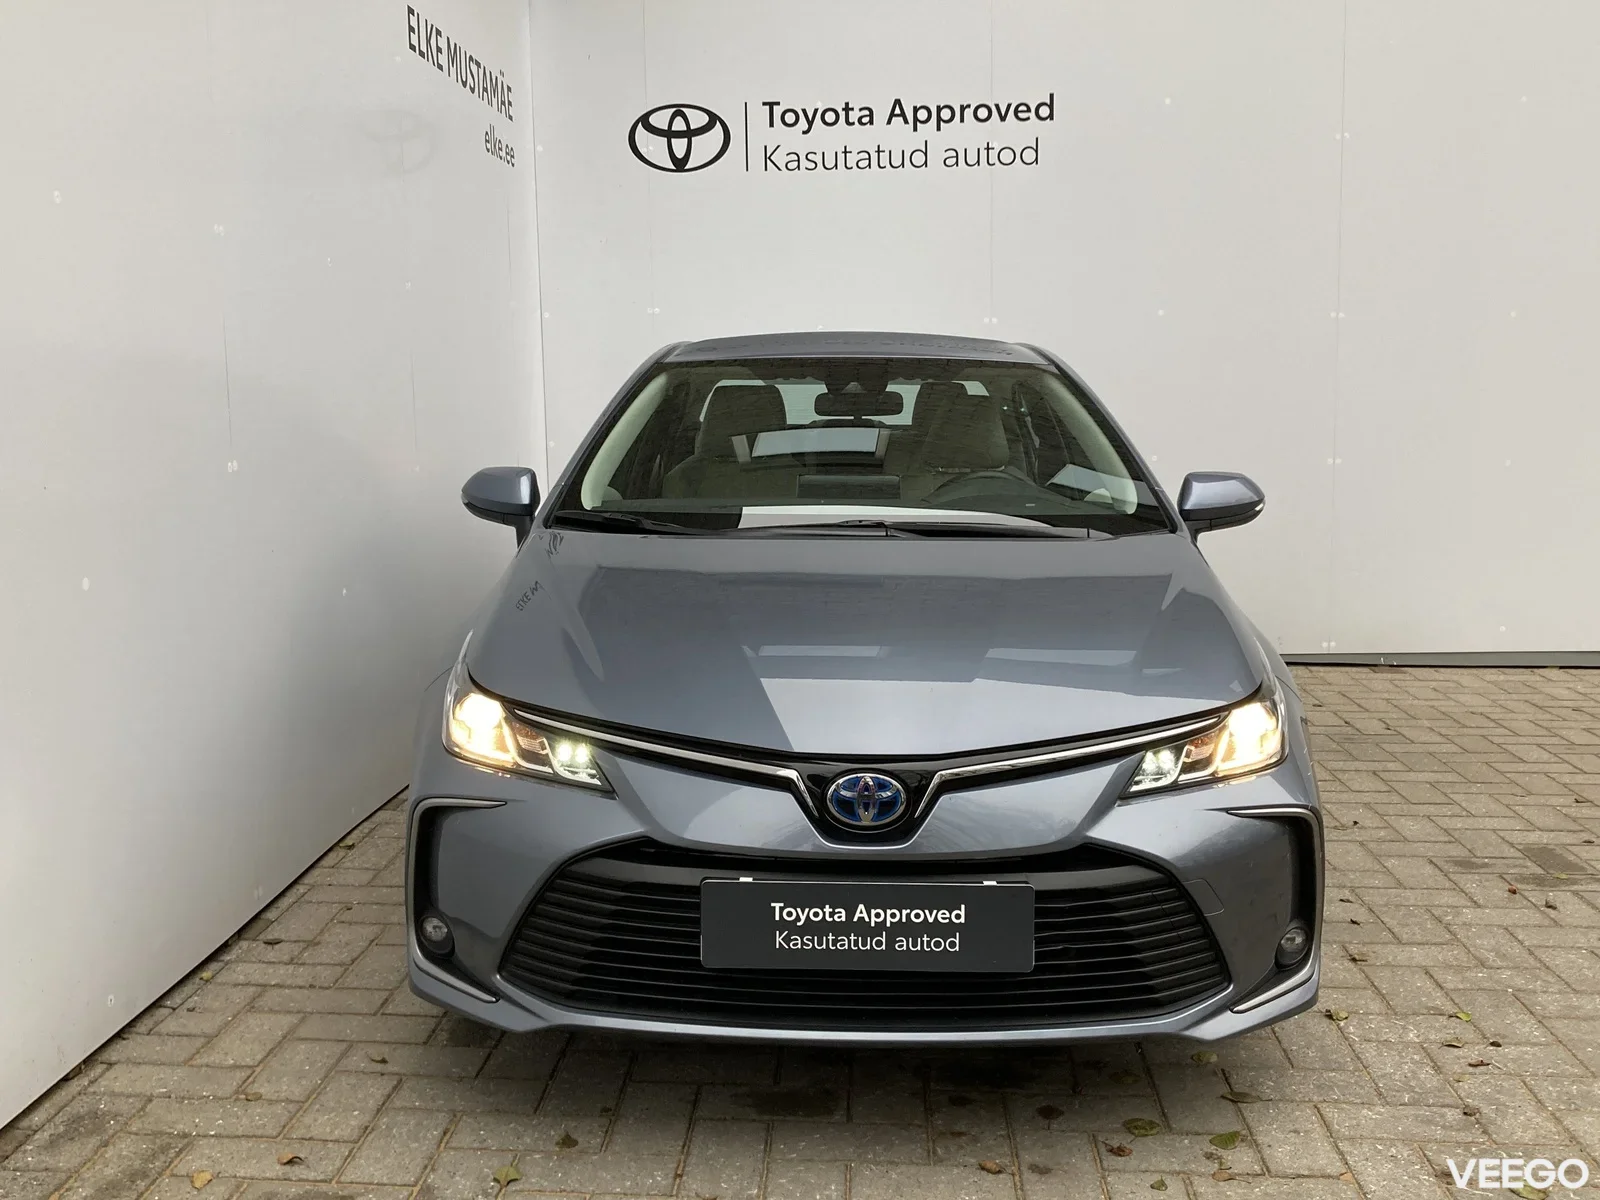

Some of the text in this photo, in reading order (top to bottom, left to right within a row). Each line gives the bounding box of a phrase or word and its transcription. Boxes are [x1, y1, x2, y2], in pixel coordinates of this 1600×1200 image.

[406, 4, 514, 122] ELKE MUSTAMÄE
[761, 92, 1055, 136] Toyota Approved
[484, 123, 515, 168] elke.ee
[763, 136, 1039, 172] Kasutatud autod
[770, 902, 966, 928] Toyota Approved
[775, 930, 960, 952] Kasutatud autod
